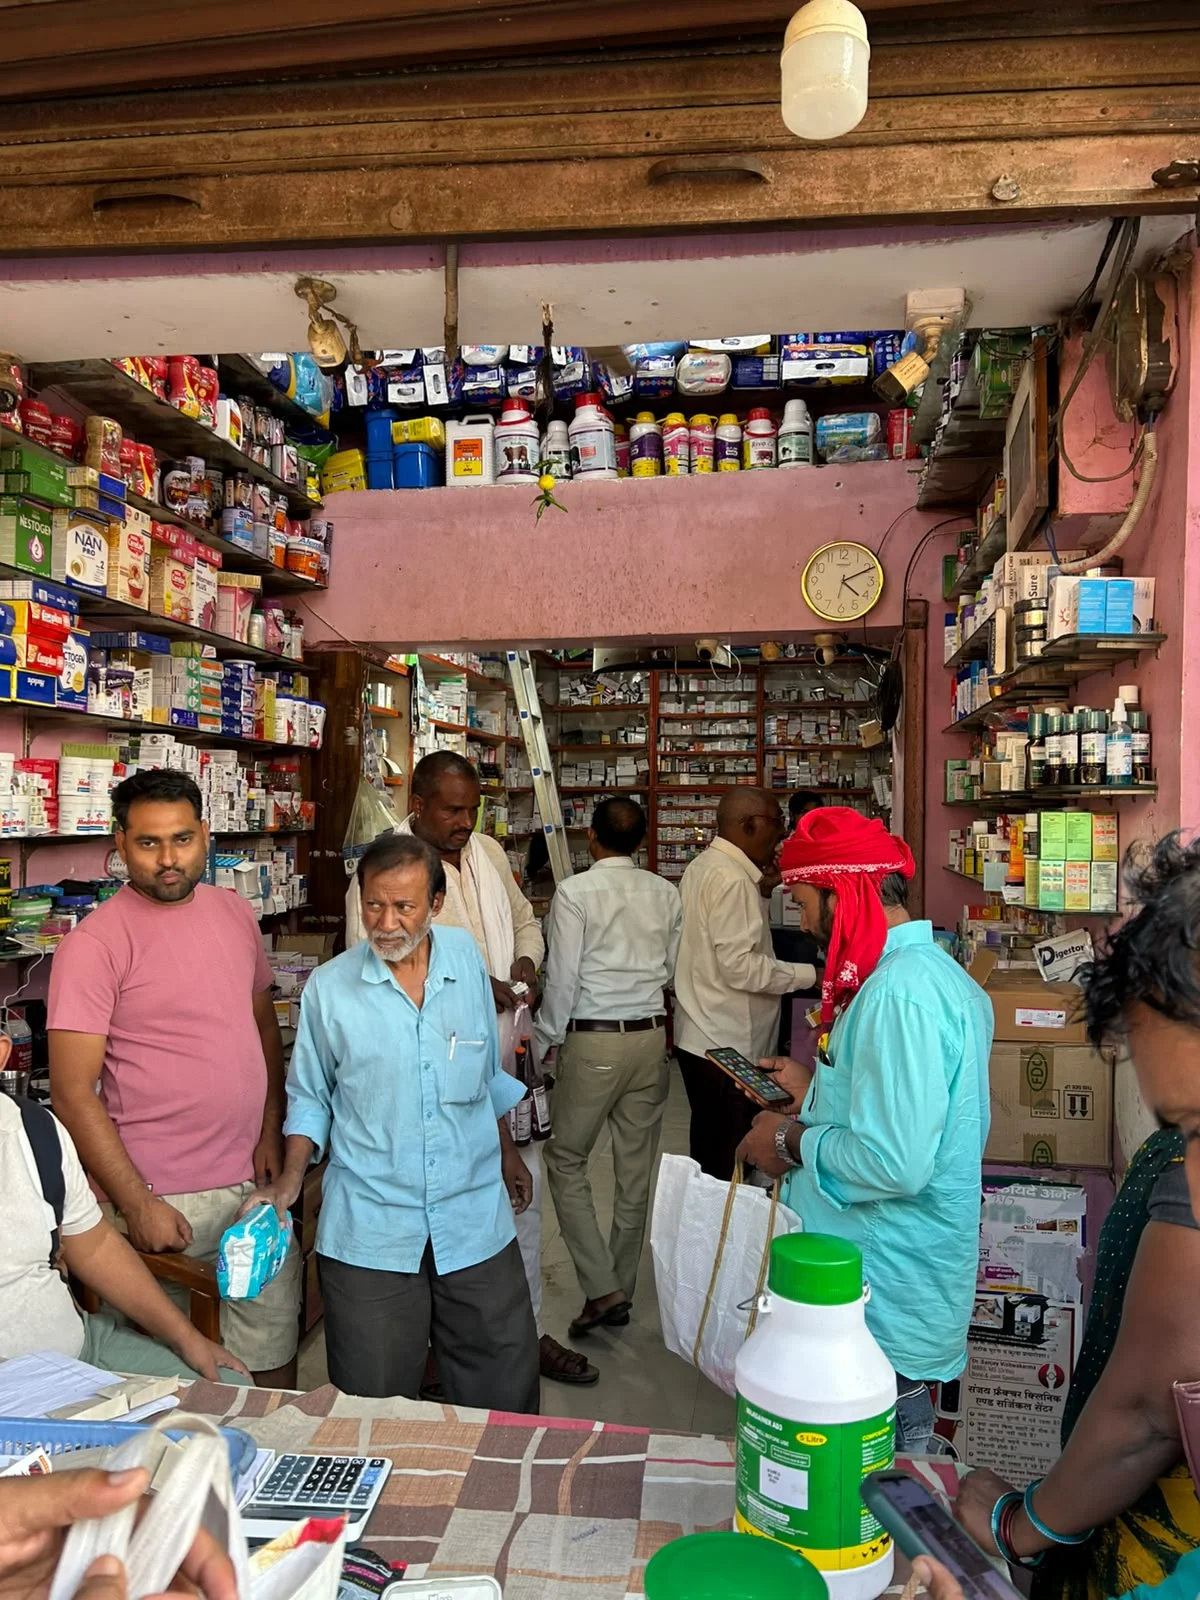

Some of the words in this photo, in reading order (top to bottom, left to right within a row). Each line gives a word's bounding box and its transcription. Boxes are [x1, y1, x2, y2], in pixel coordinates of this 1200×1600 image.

[20, 514, 51, 536] NESTOGEN
[75, 531, 102, 551] NAN
[35, 544, 39, 556] 2
[82, 548, 95, 556] PRO
[840, 549, 848, 559] 12
[827, 552, 833, 563] 11
[100, 561, 104, 569] 2
[816, 563, 825, 573] 10
[811, 576, 818, 586] 9
[867, 576, 874, 586] 3
[1029, 575, 1038, 597] Sure
[815, 590, 823, 600] 8
[862, 591, 869, 600] 4
[825, 600, 832, 609] 7
[838, 604, 845, 613] 6
[851, 600, 858, 610] 5
[64, 652, 85, 664] CTOGEN
[66, 672, 71, 684] 2
[1038, 945, 1085, 967] Digestor
[1031, 1060, 1044, 1085] FDC
[968, 1384, 990, 1395] संजय
[1024, 1389, 1062, 1402] क्लिनिक
[996, 1398, 1032, 1411] सर्जिकल
[1034, 1402, 1054, 1412] सेंटर
